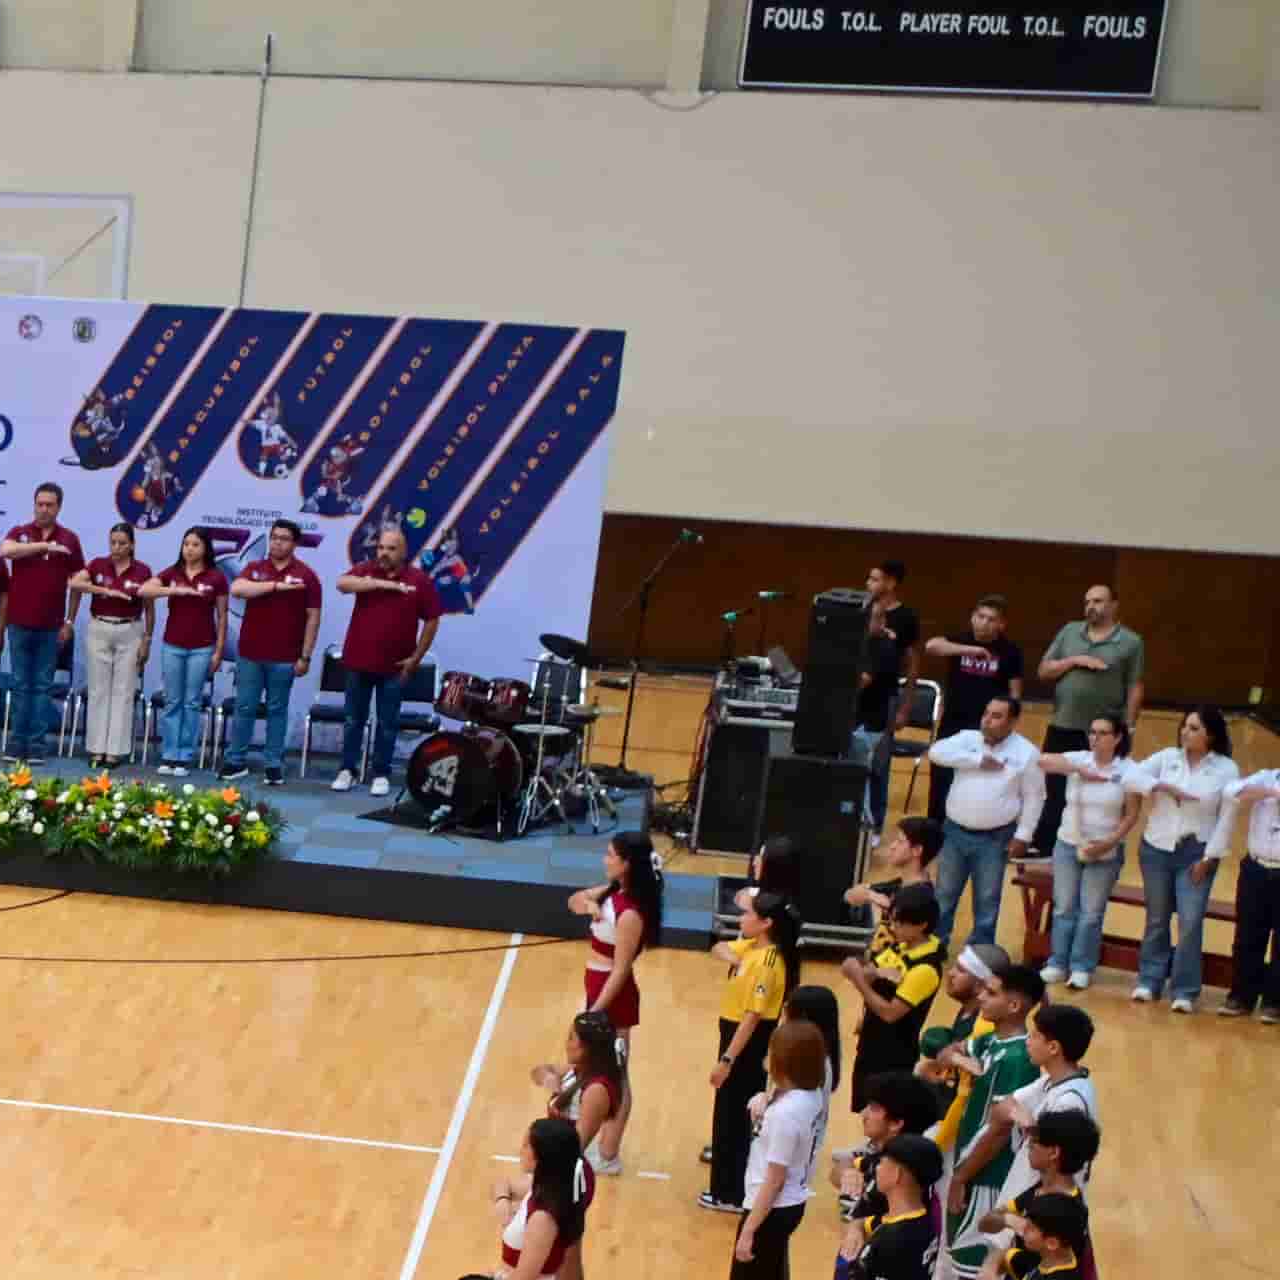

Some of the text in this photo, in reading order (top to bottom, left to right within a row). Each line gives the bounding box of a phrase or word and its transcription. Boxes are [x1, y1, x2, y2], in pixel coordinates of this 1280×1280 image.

[762, 7, 1146, 39] FOULS T.O.L. PLAYER FOUL T.O.L. FOULS
